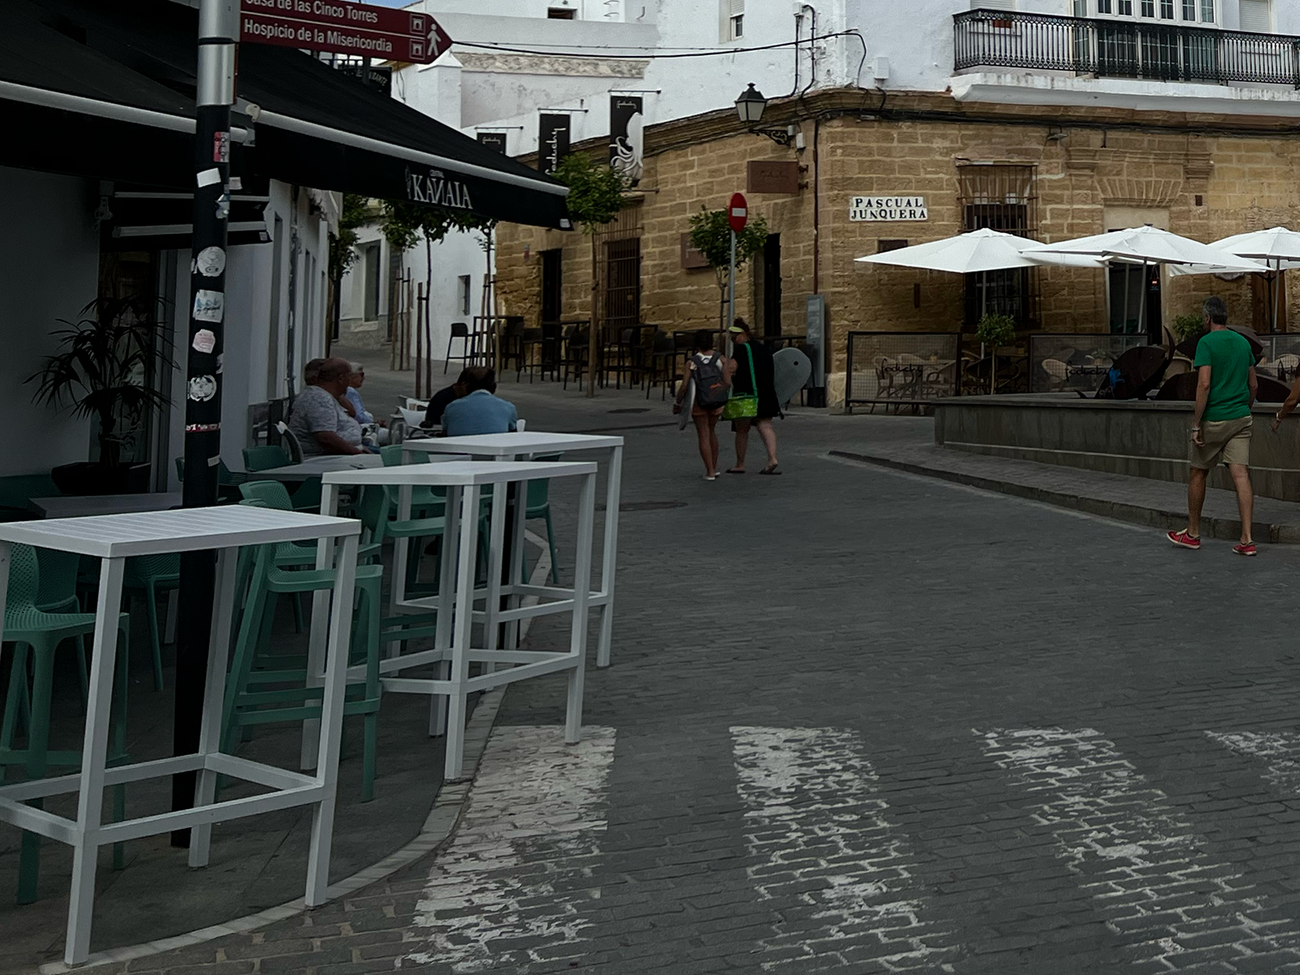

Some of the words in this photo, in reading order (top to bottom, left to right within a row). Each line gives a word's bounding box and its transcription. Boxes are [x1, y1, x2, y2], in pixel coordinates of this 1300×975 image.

[313, 0, 344, 18] Cinco
[346, 5, 378, 23] Torres
[244, 19, 295, 39] Hospicio
[297, 26, 312, 42] de
[314, 28, 325, 43] la
[327, 30, 393, 53] Misericordia
[855, 198, 923, 208] PASCUAL
[851, 209, 926, 219] JUNQUERA
